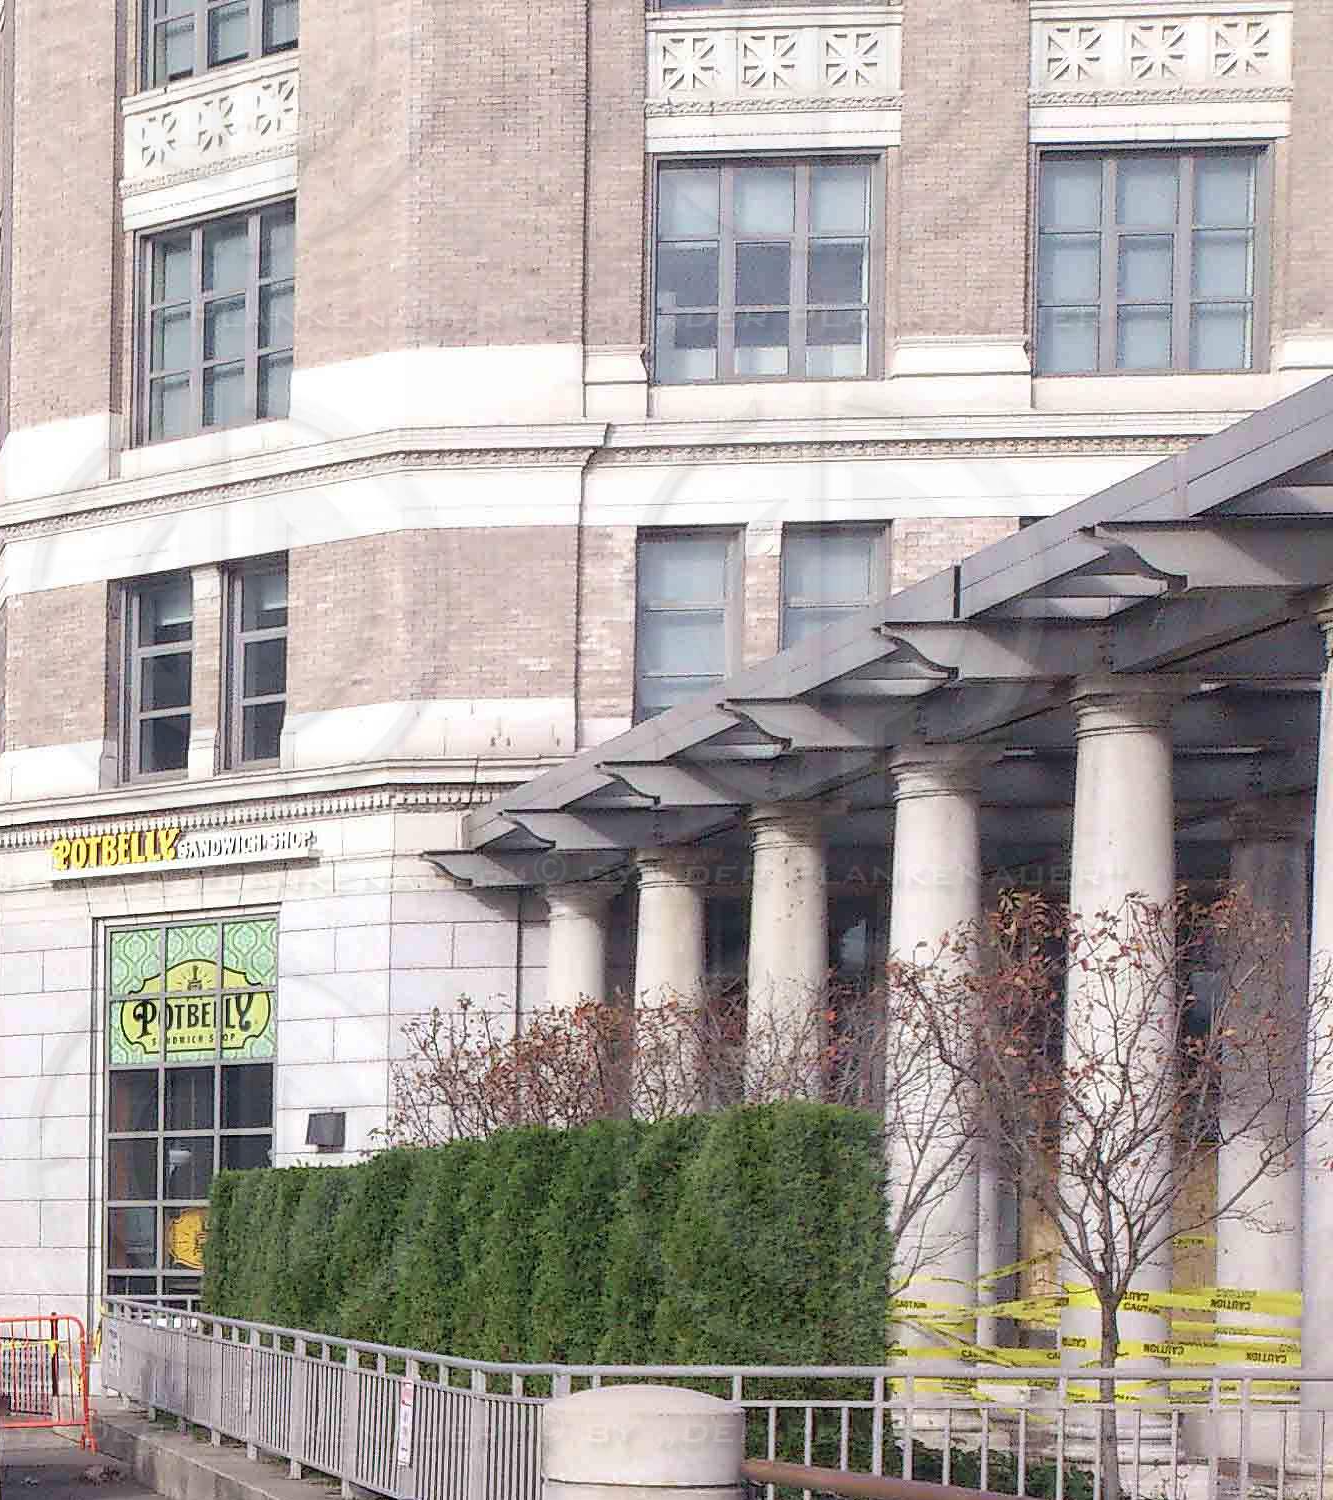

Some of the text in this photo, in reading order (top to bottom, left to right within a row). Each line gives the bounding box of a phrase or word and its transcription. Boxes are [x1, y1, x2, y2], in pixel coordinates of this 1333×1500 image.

[50, 827, 182, 871] POTBELLY
[1210, 1298, 1252, 1311] CAUTION
[1142, 1343, 1185, 1356] CAUTION
[1245, 1351, 1288, 1364] CAUTION
